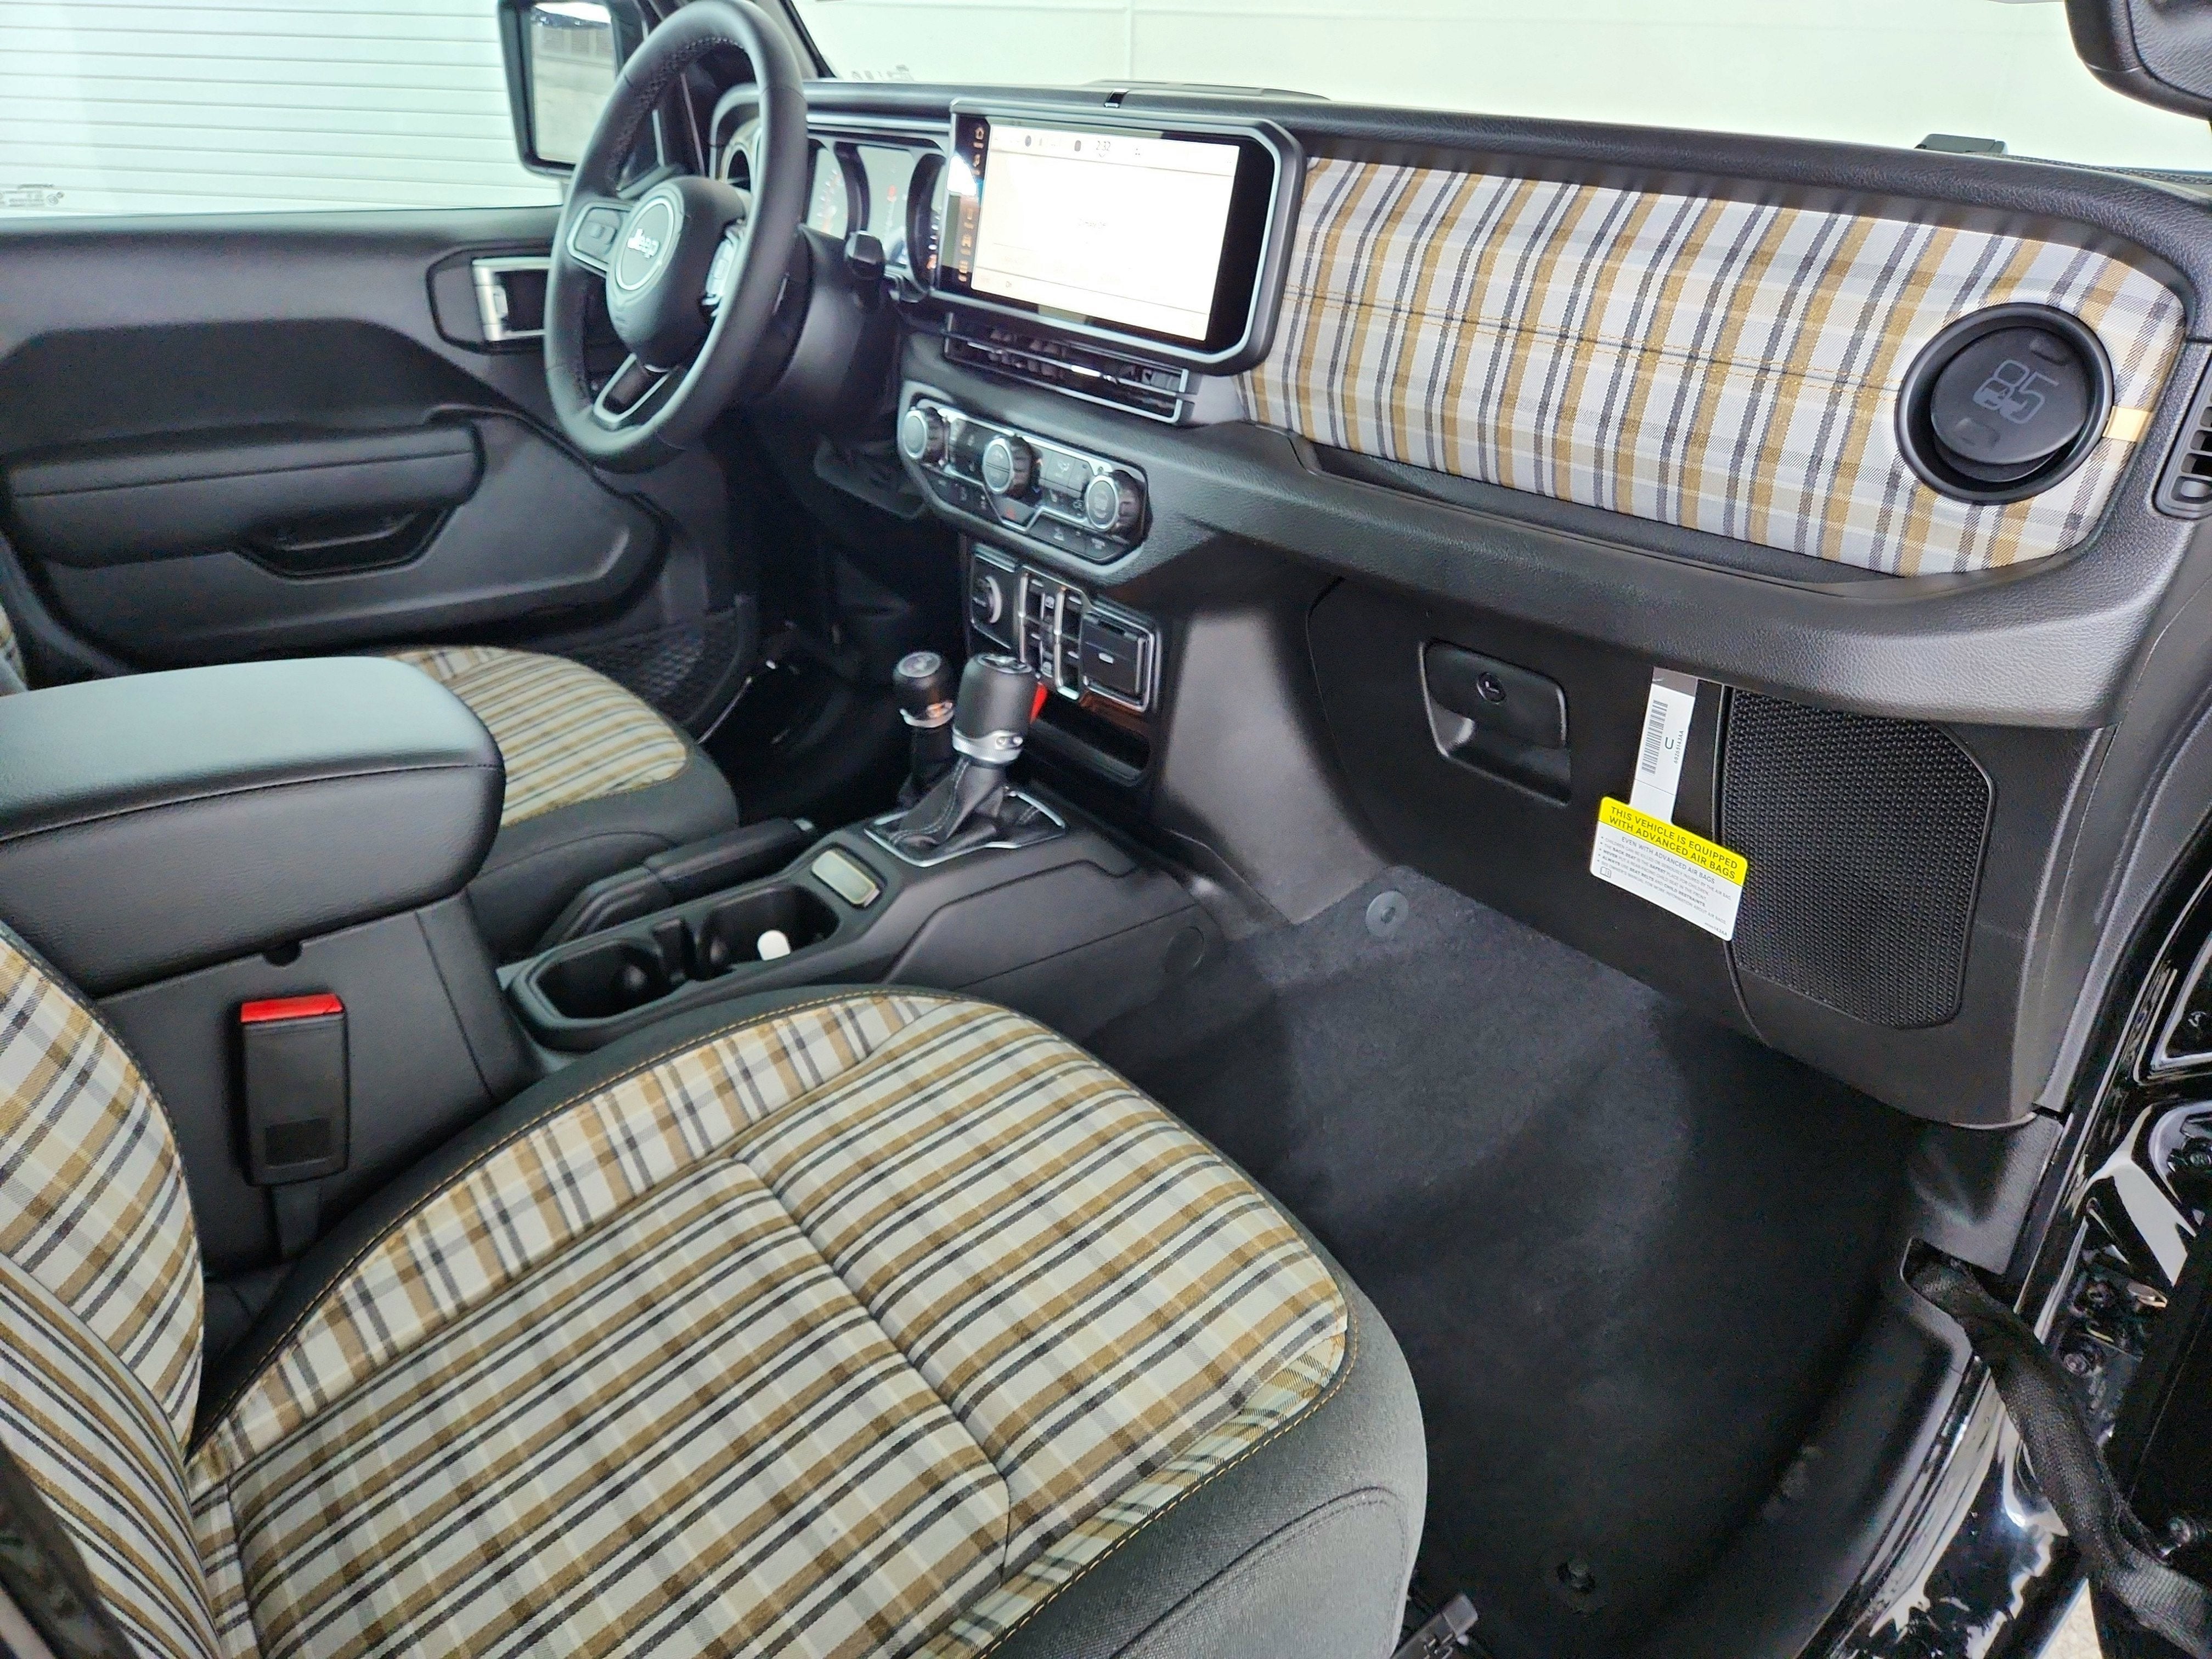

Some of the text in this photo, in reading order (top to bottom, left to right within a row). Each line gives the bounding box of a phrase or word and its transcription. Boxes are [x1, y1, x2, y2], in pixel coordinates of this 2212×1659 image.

[1665, 737, 1674, 750] U
[1609, 815, 1735, 879] WITH ADVANCED AIR BAGS
[1611, 806, 1737, 869] THIS VEHICLE IS EQUIPPED
[1622, 836, 1715, 884] EVEN WITH ADVANCED AIR BAGS
